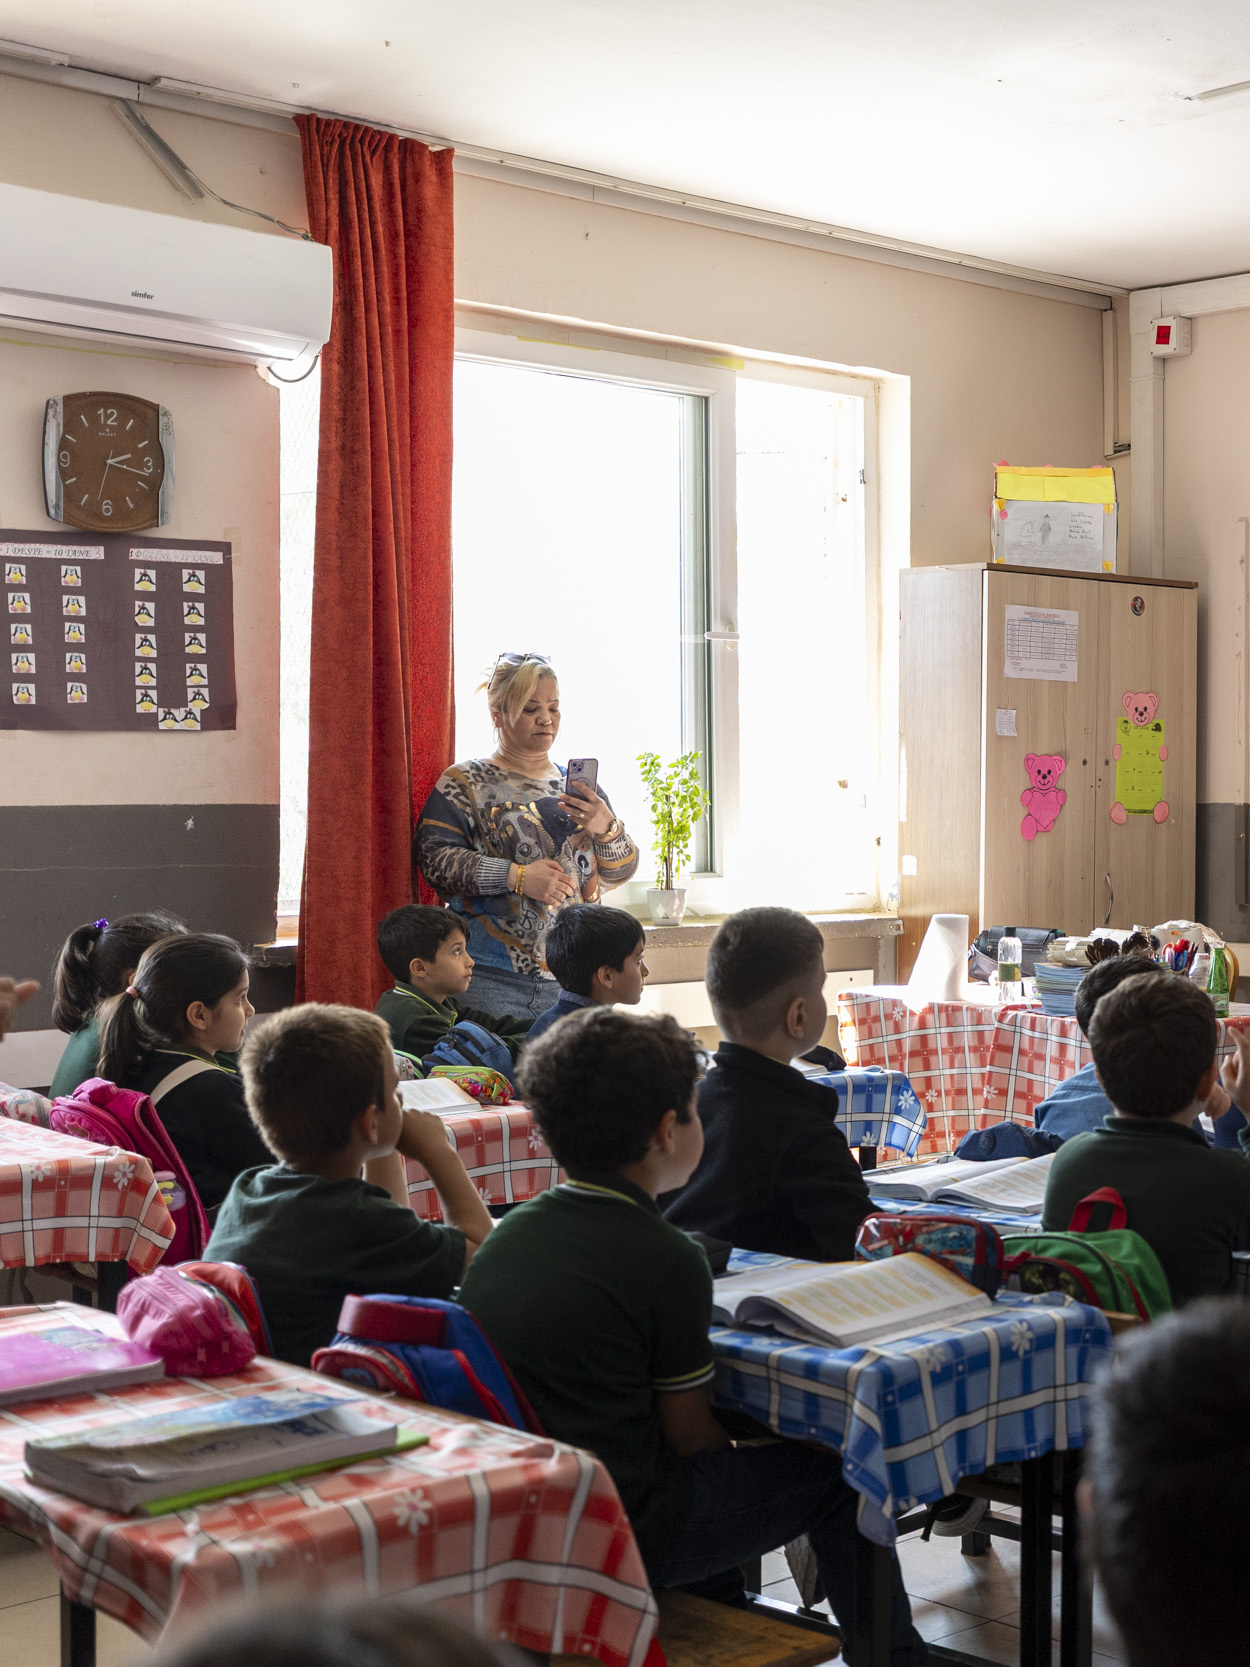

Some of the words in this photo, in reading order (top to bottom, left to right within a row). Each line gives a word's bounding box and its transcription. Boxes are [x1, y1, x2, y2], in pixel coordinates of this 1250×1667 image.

[131, 290, 154, 300] simfer
[98, 408, 117, 425] 12
[60, 451, 70, 467] 9
[144, 457, 153, 472] 3
[102, 500, 112, 516] 6
[13, 547, 43, 556] DESTE
